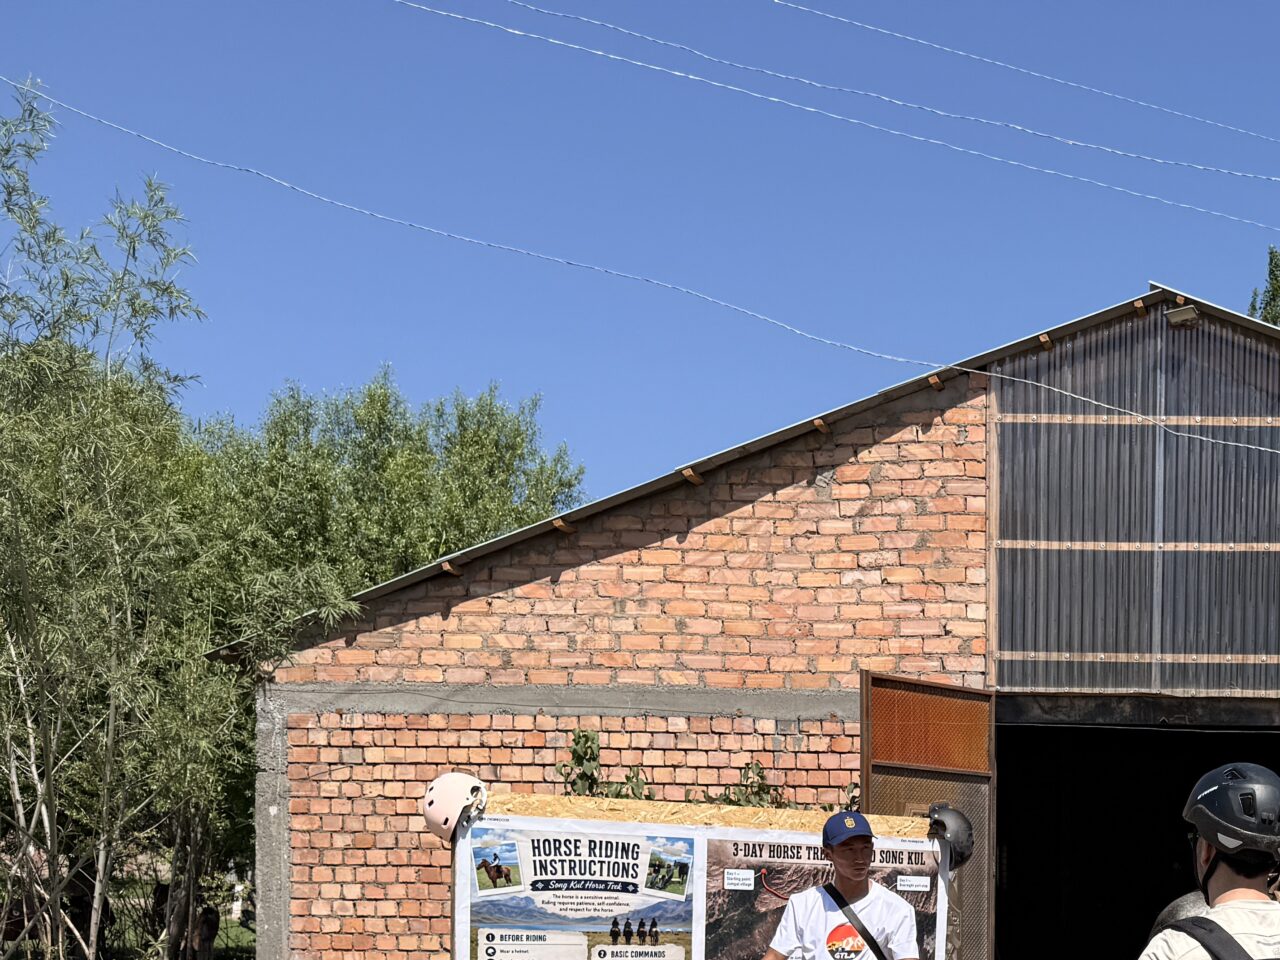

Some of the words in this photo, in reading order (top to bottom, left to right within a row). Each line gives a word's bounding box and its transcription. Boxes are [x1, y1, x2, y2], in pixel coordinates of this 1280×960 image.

[530, 839, 582, 857] HORSE
[588, 839, 640, 861] RIDING
[733, 842, 764, 858] 3-DAY
[768, 844, 802, 860] HORSE
[879, 850, 904, 865] SONG
[907, 852, 926, 866] KUL
[532, 859, 639, 880] INSTRUCTIONS
[549, 881, 567, 890] Song
[585, 881, 605, 889] Horse
[607, 882, 622, 890] Trek
[500, 934, 524, 942] BEFORE
